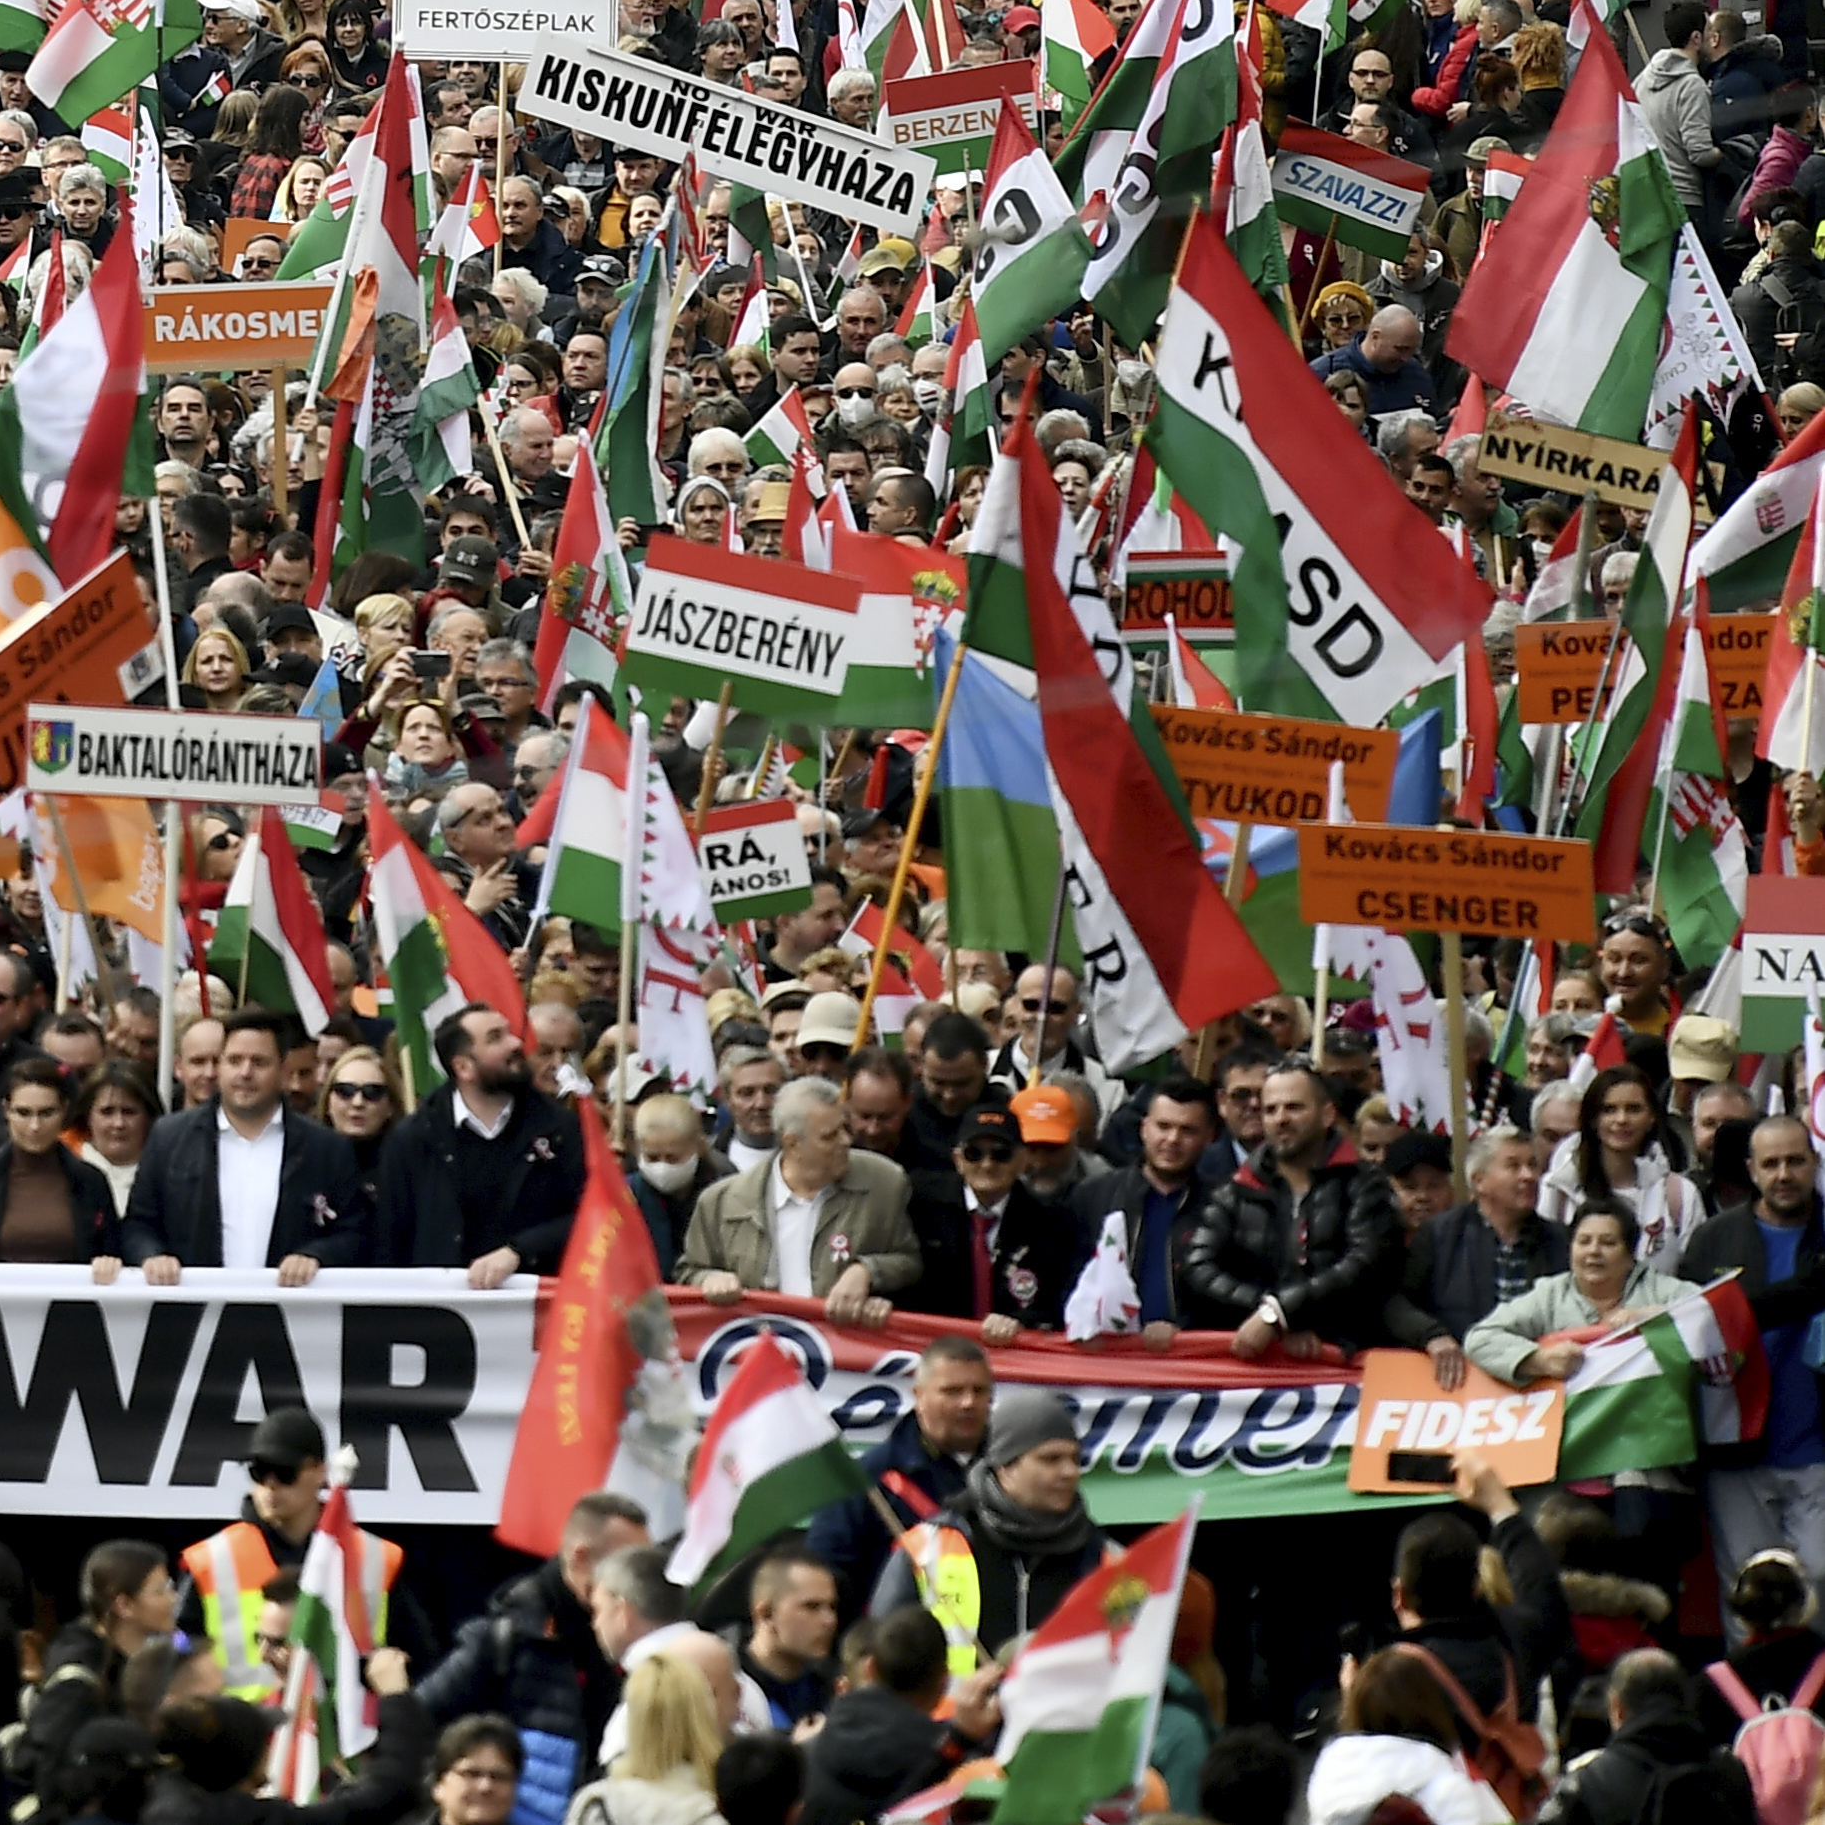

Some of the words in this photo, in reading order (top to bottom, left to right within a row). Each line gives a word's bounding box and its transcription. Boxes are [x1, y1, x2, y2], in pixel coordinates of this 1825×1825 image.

[417, 9, 595, 33] FERTŐSZÉPLAK
[671, 79, 711, 102] NO
[535, 58, 915, 215] KISKUNFÉLEGYHÁZA
[753, 106, 817, 137] WAR
[893, 109, 1035, 143] BERZENE
[1285, 160, 1408, 225] SZAVAZZ!
[638, 589, 846, 677] JÁSZBERÉNY
[78, 731, 318, 788] BAKTALÓRÁNTHÁZA
[1262, 723, 1375, 767] Sándor
[1184, 780, 1322, 823] TYUKOD
[1325, 836, 1440, 869] Kovács
[1445, 839, 1565, 875] Sándor
[1356, 889, 1540, 929] CSENGER
[1362, 1390, 1558, 1450] FIDESZ
